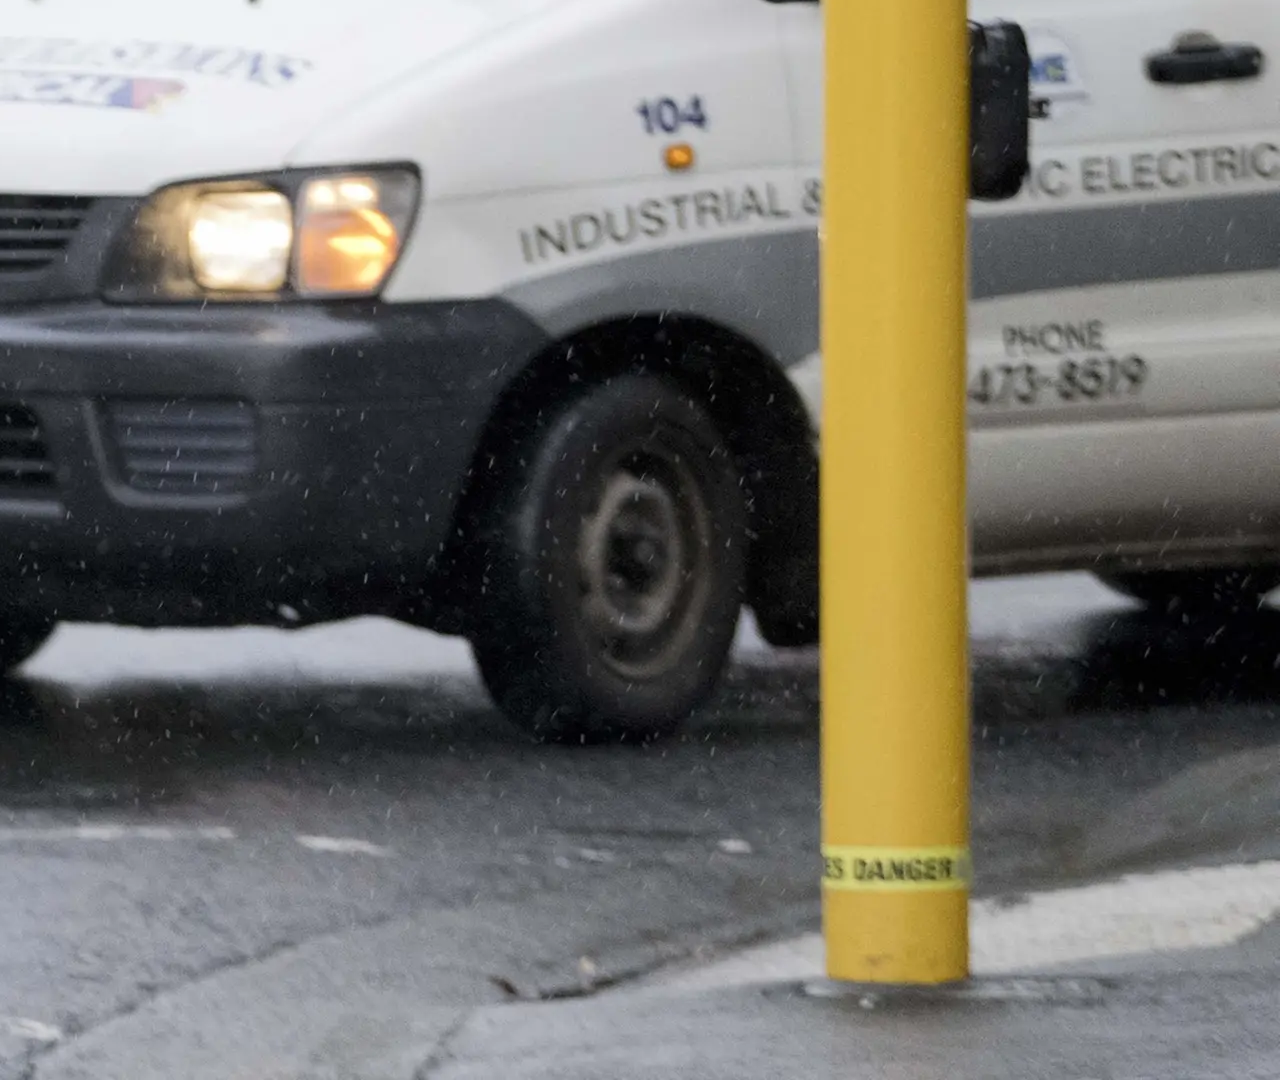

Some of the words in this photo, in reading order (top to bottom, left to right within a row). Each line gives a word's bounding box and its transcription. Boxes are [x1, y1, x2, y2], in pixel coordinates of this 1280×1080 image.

[637, 96, 708, 135] 104
[519, 182, 789, 263] INDUSTRIAL
[802, 177, 824, 216] &
[1080, 142, 1279, 195] ELECTRIC
[1003, 320, 1106, 357] PHONE
[853, 857, 953, 881] DANGER
